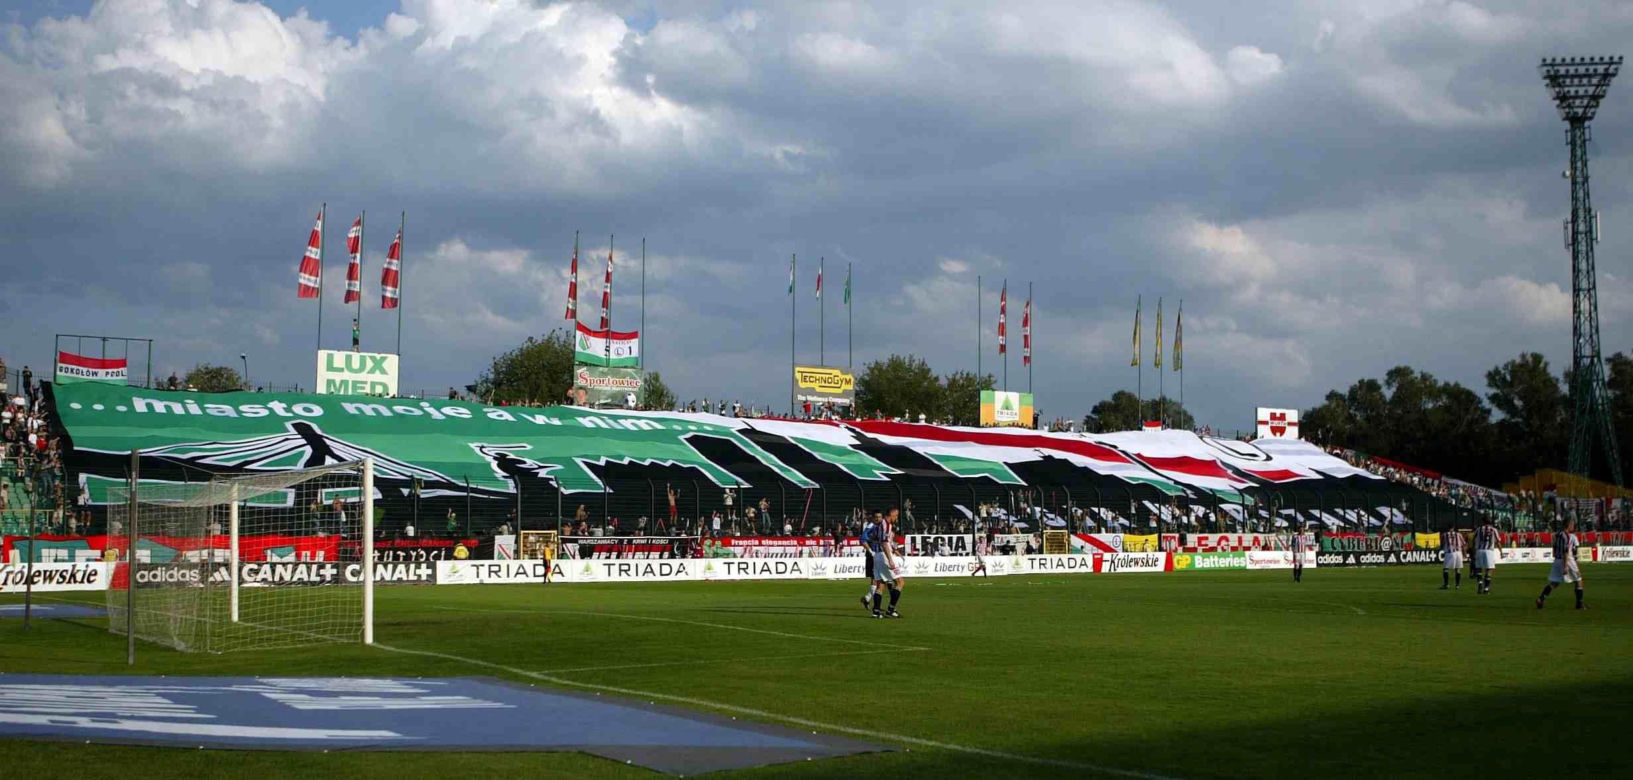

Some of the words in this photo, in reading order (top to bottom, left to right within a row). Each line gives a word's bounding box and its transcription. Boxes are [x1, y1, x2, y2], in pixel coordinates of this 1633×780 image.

[58, 365, 100, 378] SOKOŁÓW
[325, 353, 388, 375] LUX
[325, 379, 389, 396] MED
[578, 371, 641, 389] Sportowiec
[339, 401, 472, 421] moje
[483, 407, 517, 422] a
[518, 413, 564, 427] w
[1027, 557, 1088, 570] TRIADA
[1107, 554, 1159, 572] Królewskie
[1173, 555, 1192, 569] GP
[1194, 555, 1246, 568] Batteries
[1317, 555, 1343, 564] adidas
[1360, 552, 1385, 563] adidas
[1400, 551, 1437, 563] CANAL+
[136, 567, 200, 582] adidas
[241, 563, 337, 582] CANAL+
[471, 563, 565, 579] TRIADA
[602, 562, 688, 577] TRIADA
[723, 561, 802, 576] TRIADA
[834, 563, 866, 575] Liberty
[934, 562, 966, 573] Liberty
